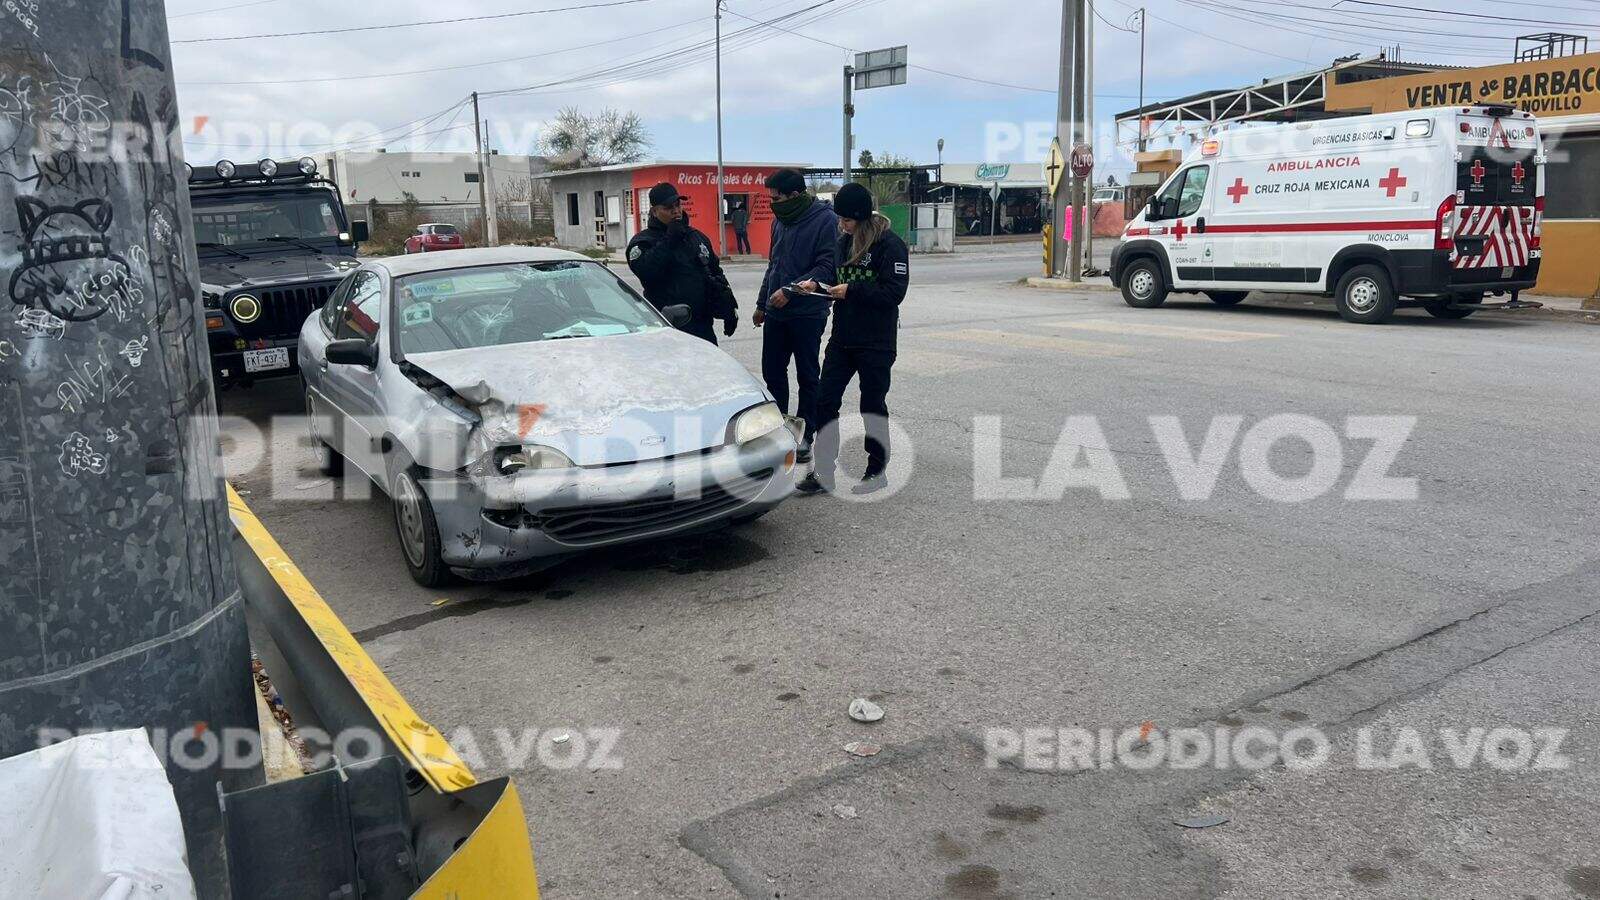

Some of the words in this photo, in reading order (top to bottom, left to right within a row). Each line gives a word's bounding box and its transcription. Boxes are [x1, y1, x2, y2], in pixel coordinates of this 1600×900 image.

[1406, 81, 1472, 108] VENTA
[1479, 79, 1499, 96] de
[1521, 95, 1582, 112] NOVILLO
[1312, 133, 1351, 146] URGENCIAS
[1072, 154, 1093, 168] ALTO
[1267, 156, 1361, 173] AMBULANCIA
[677, 172, 702, 185] Ricos
[706, 172, 740, 185] Taales
[742, 172, 753, 185] de
[1254, 184, 1280, 195] CRUZ
[1284, 182, 1311, 193] ROJA
[1314, 178, 1371, 192] MEXICANA
[1367, 233, 1410, 242] MONCLOVA
